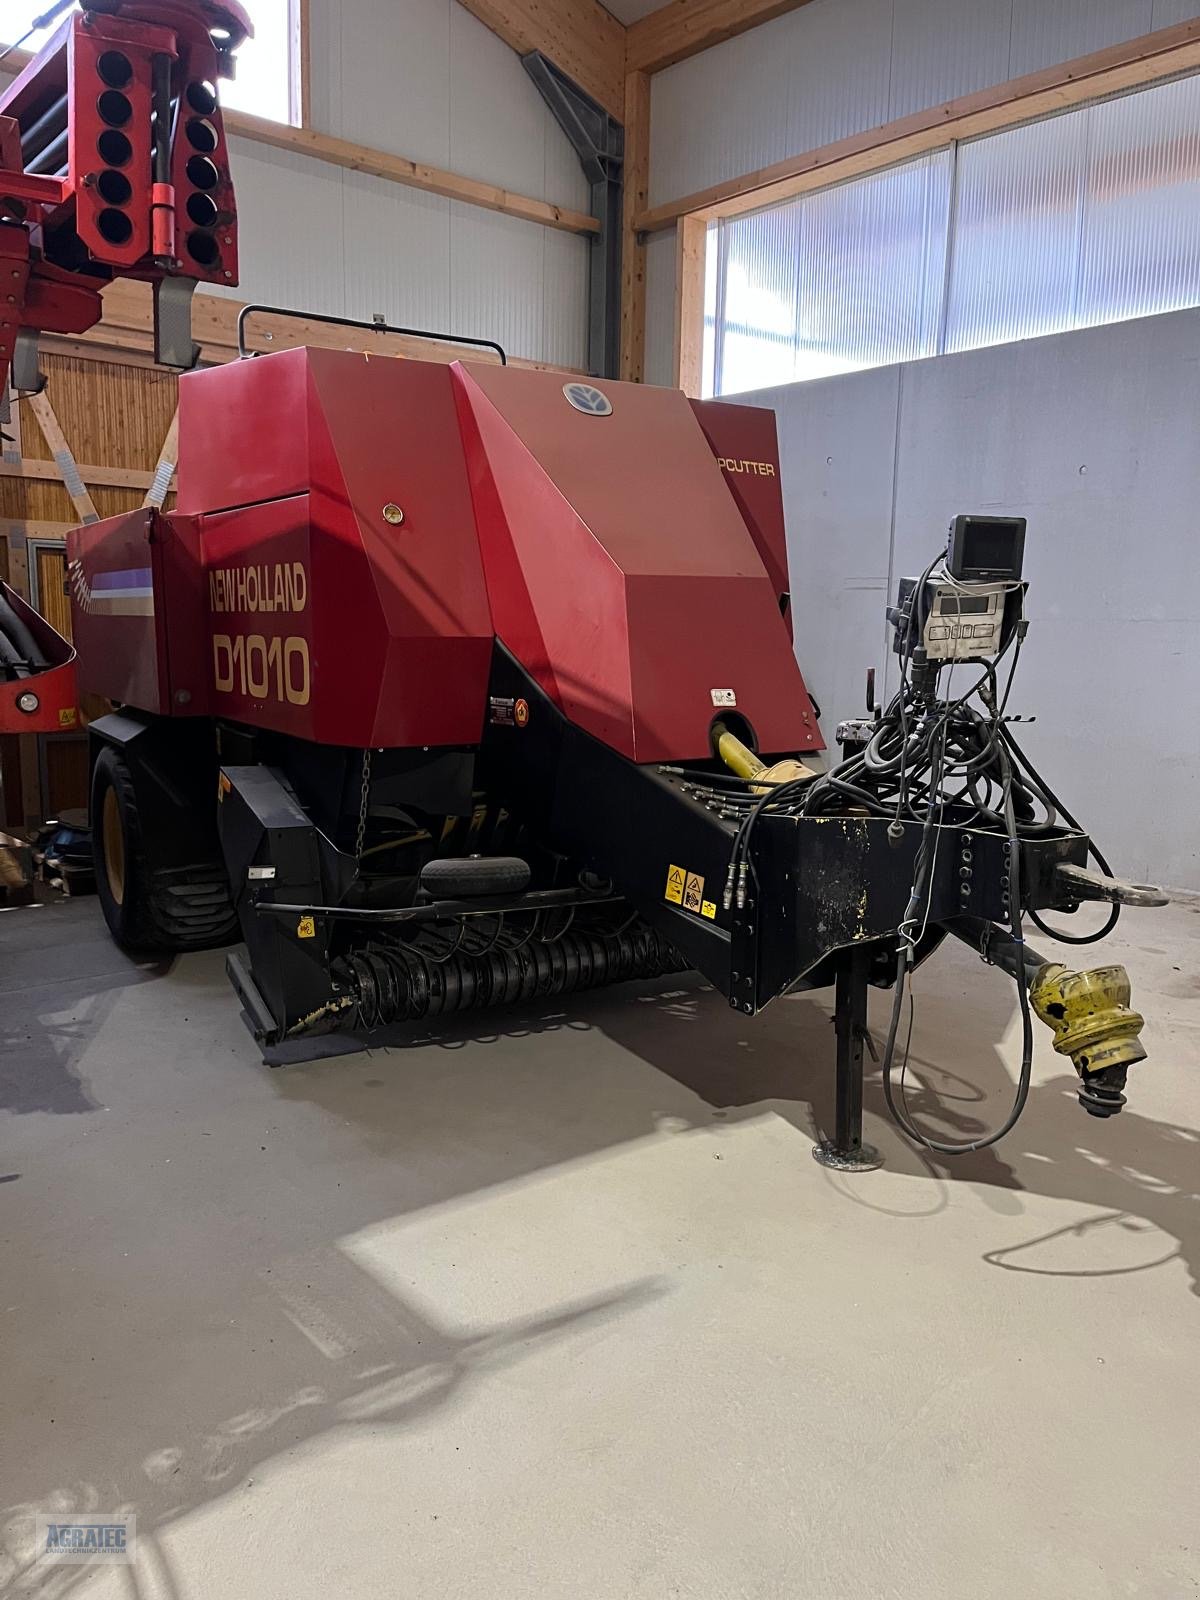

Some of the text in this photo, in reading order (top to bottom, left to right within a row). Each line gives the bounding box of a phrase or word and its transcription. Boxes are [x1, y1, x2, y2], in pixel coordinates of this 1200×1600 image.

[209, 562, 307, 612] NEW HOLLAND
[213, 634, 310, 705] D1010
